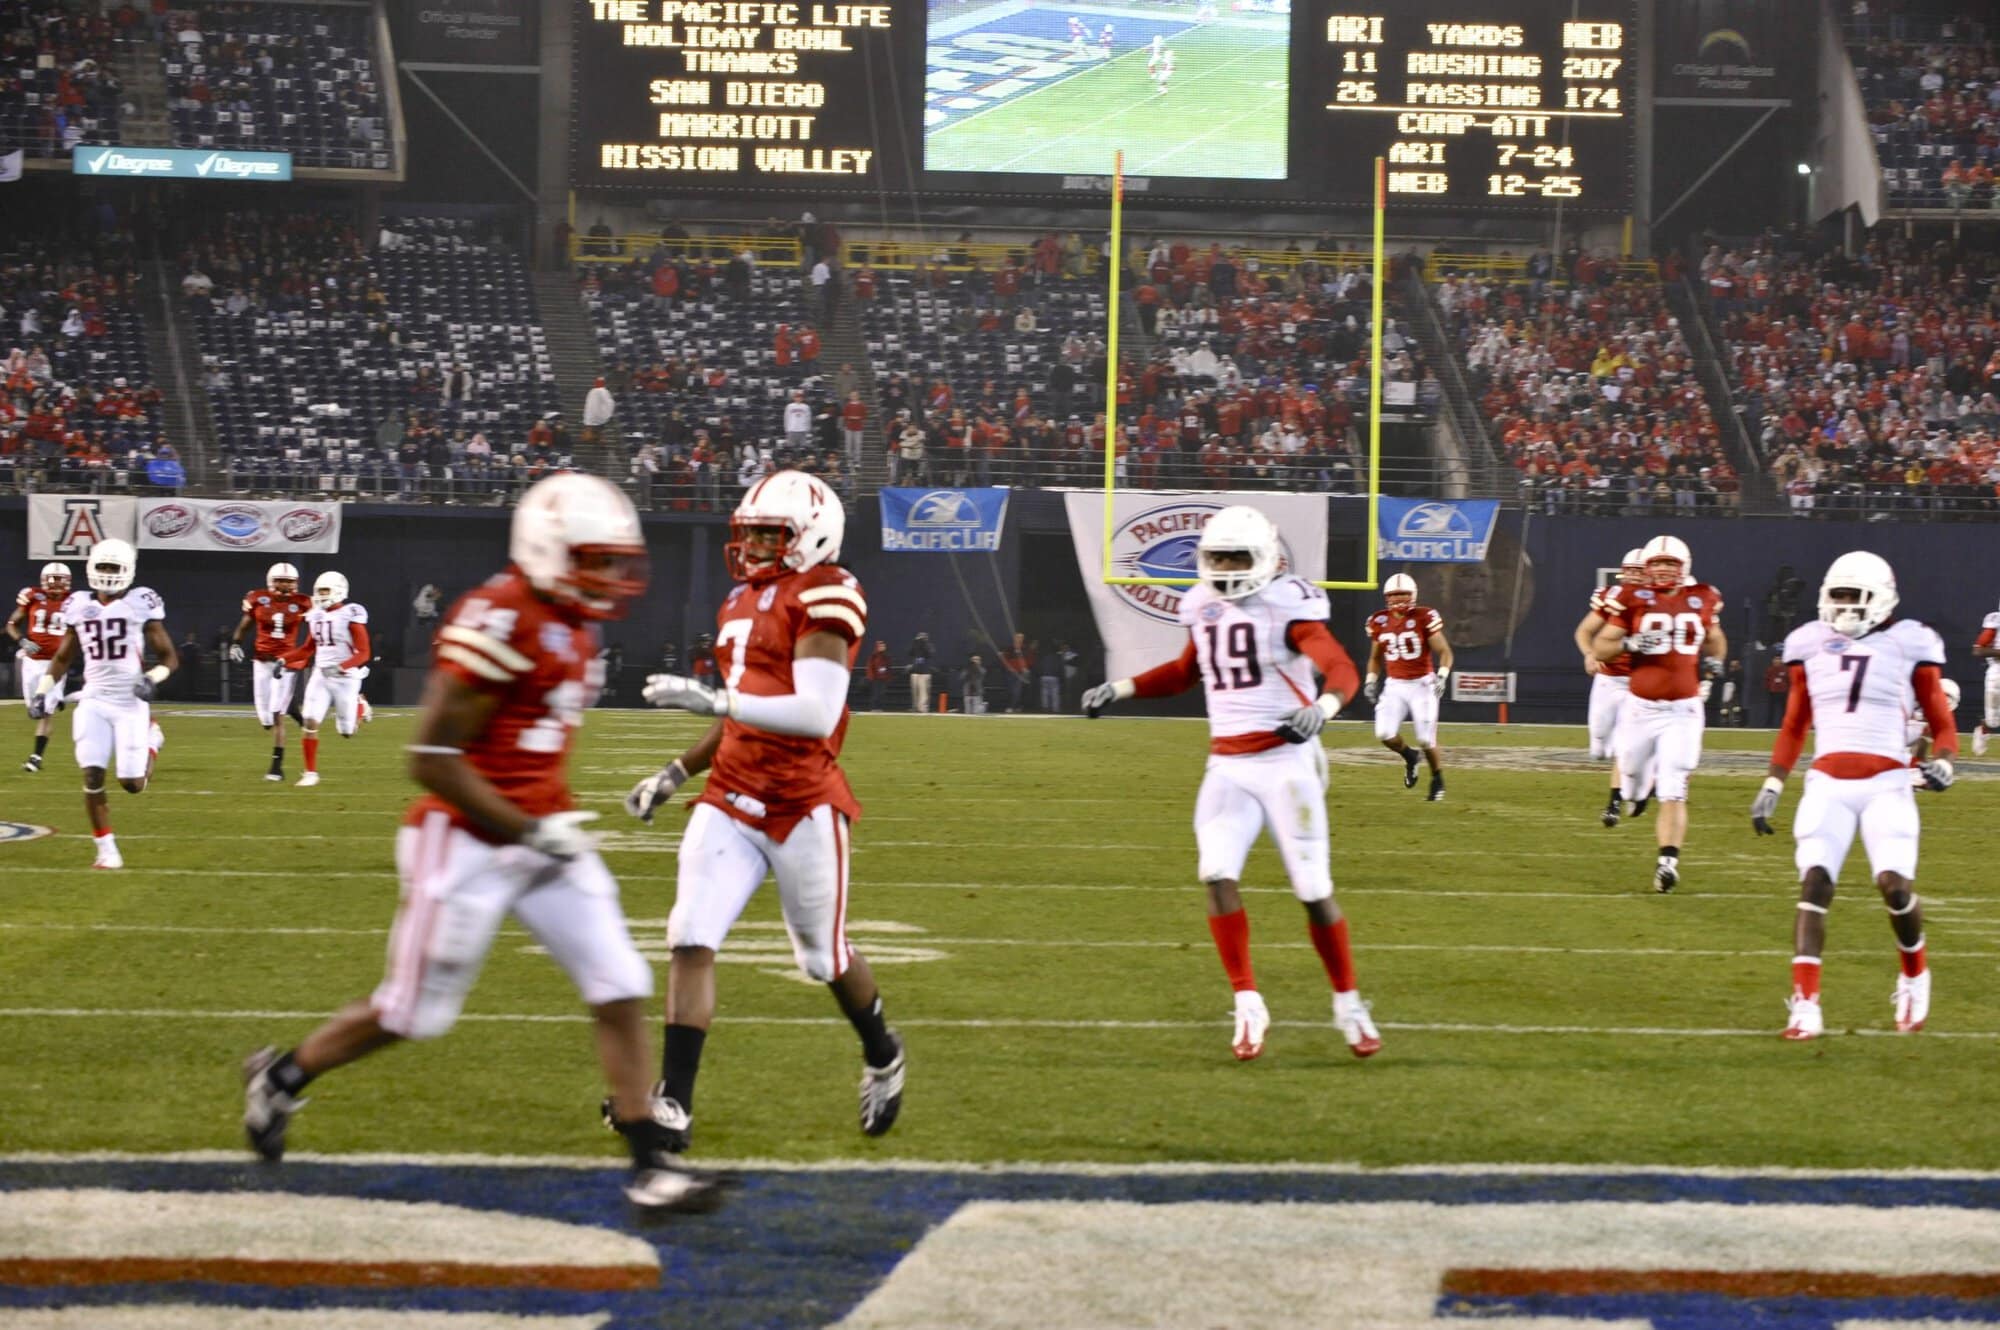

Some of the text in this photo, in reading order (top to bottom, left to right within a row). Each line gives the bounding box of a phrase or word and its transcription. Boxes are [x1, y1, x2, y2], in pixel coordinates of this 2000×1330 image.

[590, 0, 891, 27] THE PACIFIC LIFE
[623, 25, 852, 50] HOLIDAY BOWL
[1327, 16, 1622, 49] ARI YARDS NEB
[681, 51, 798, 74] THANKS
[1342, 52, 1622, 78] 11 RUSHING 207
[650, 80, 825, 107] SAN DIEGO
[1337, 81, 1621, 108] 26 PASSING 174
[659, 113, 815, 139] MARRIOTT
[1398, 113, 1551, 136] COMP-ATT
[107, 154, 280, 176] Degree Degree
[601, 144, 872, 174] MISSION VALLEY
[1389, 143, 1574, 167] ARI 7-24
[1388, 172, 1582, 197] NEB 12-25
[809, 484, 825, 507] N
[54, 498, 106, 556] A
[881, 527, 998, 550] PACIFIC LIF
[1377, 539, 1453, 561] PACIFIC
[84, 618, 128, 660] 32
[270, 612, 286, 639] 1
[1640, 612, 1706, 655] 80
[716, 618, 753, 690] 7
[1205, 622, 1263, 690] 19
[1377, 631, 1422, 662] 30
[1840, 655, 1872, 713] 7
